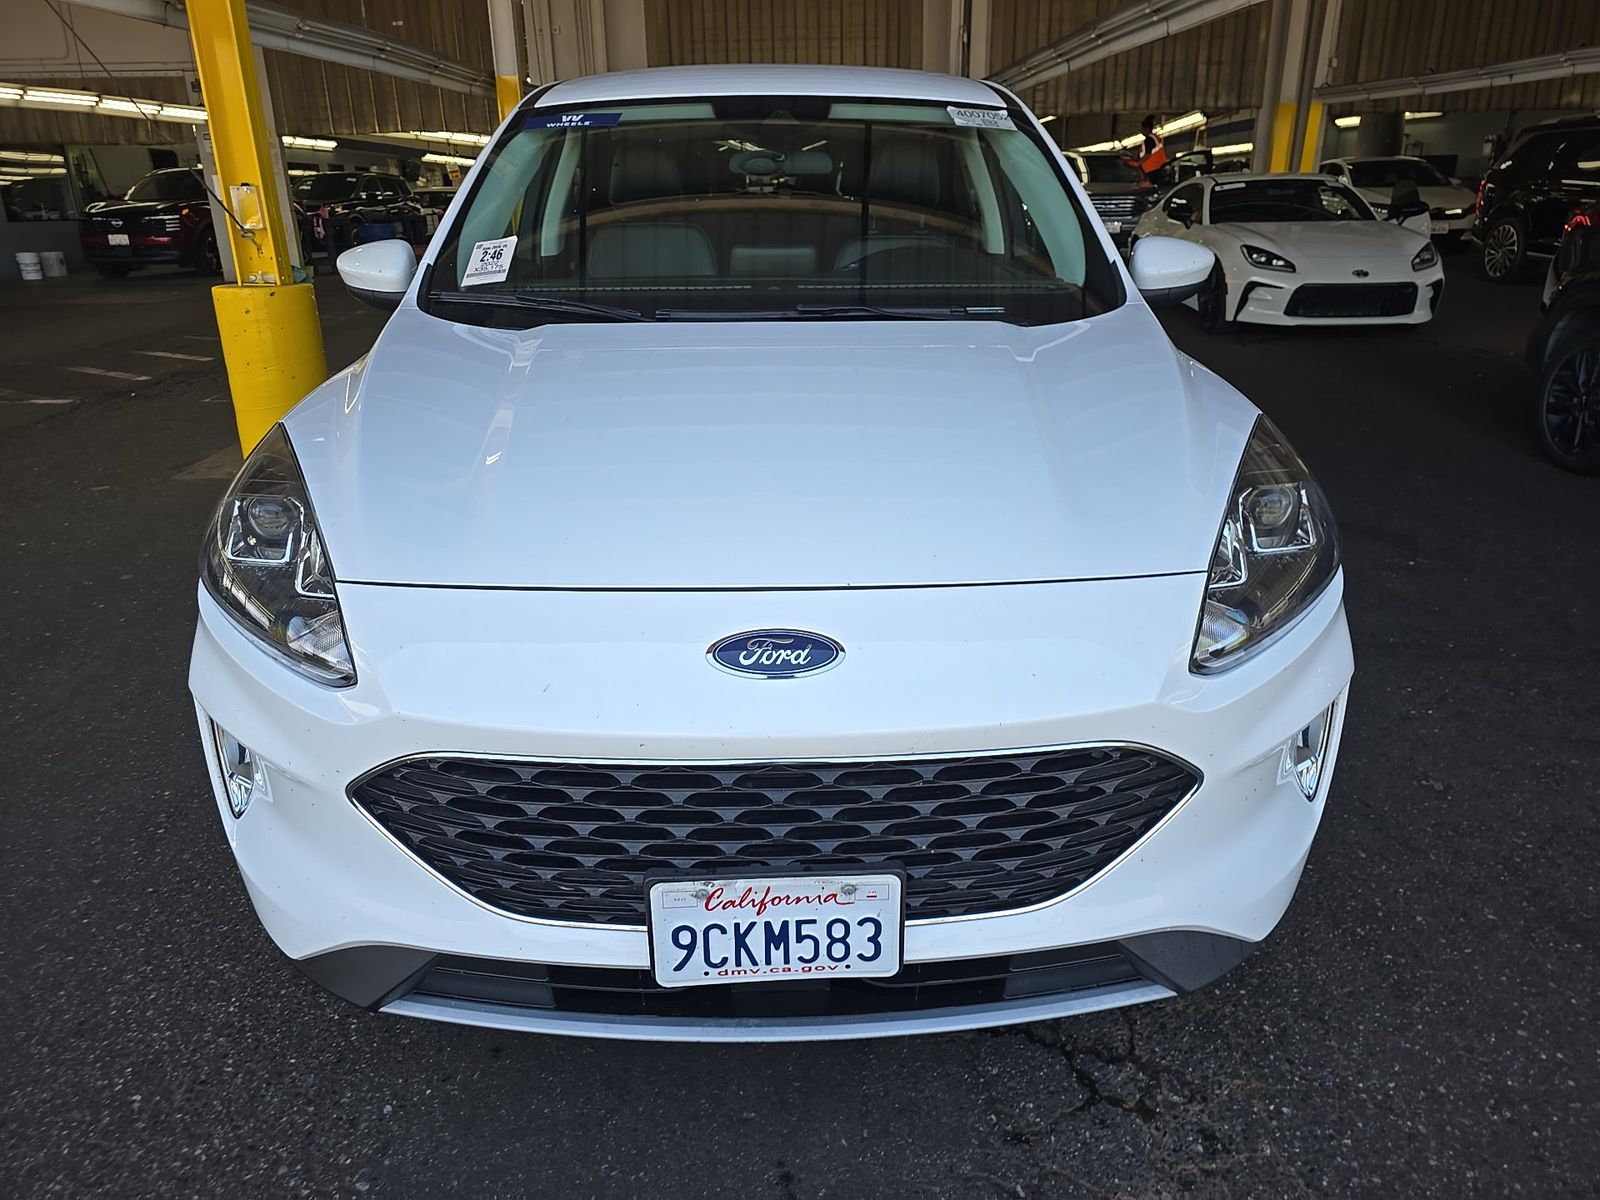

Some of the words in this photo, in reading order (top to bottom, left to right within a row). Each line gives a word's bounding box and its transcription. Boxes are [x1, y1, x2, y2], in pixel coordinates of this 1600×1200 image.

[480, 249, 504, 262] 2:46
[738, 637, 813, 666] Ford
[704, 885, 855, 916] California
[671, 916, 883, 972] 9CKM583
[717, 964, 839, 977] dmv.ca.gov
